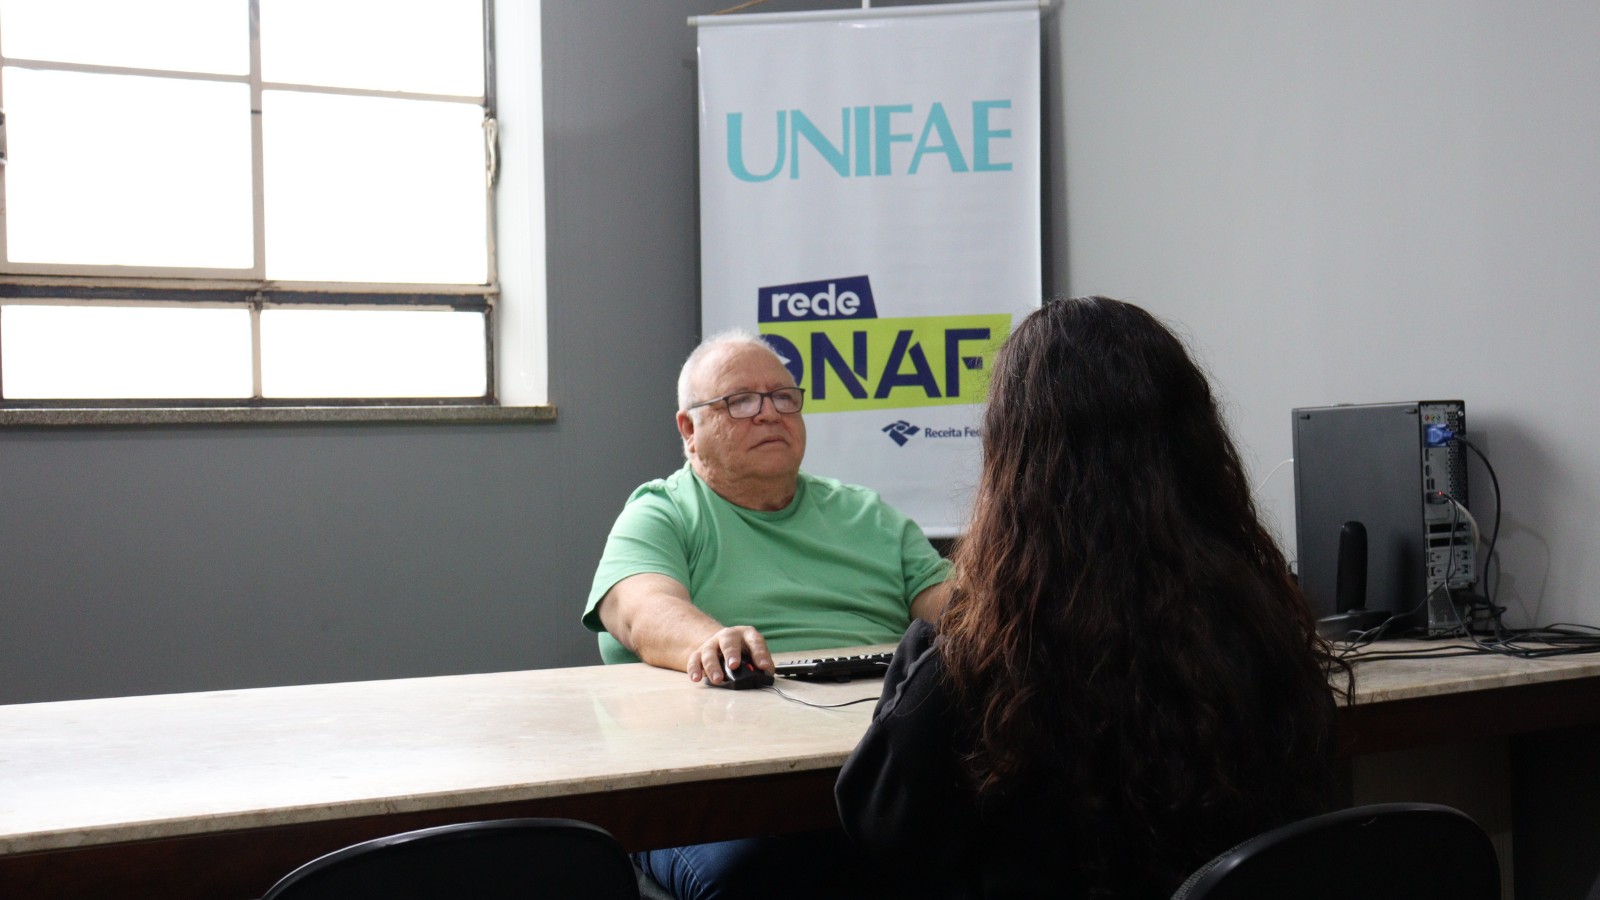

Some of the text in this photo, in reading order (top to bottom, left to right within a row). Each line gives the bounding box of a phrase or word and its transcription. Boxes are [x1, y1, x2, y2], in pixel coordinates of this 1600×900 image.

[726, 100, 1013, 182] UNIFAE
[771, 283, 861, 318] rede
[924, 427, 962, 438] Receita
